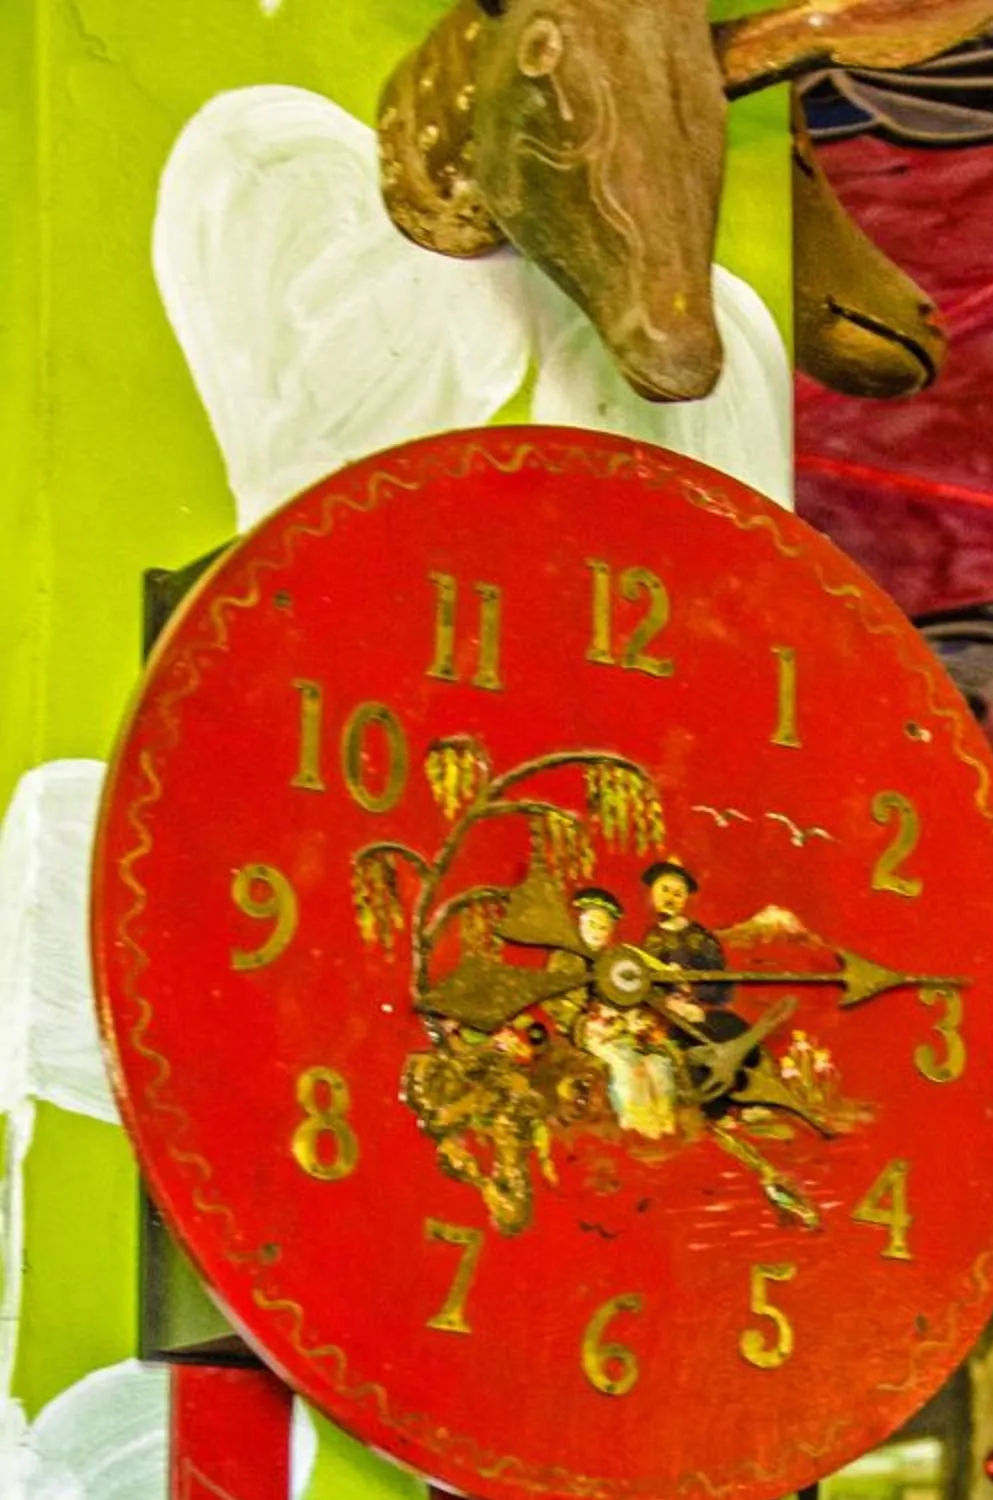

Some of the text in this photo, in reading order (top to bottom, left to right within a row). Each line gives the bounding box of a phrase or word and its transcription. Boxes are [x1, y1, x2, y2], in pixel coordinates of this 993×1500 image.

[427, 573, 504, 692] 11
[585, 558, 675, 679] 12
[291, 680, 407, 813] 10
[770, 647, 803, 748] 1
[870, 792, 923, 899] 2
[230, 864, 298, 971] 9
[912, 983, 968, 1083] 3
[292, 1067, 359, 1180] 8
[853, 1159, 913, 1261] 4
[424, 1218, 485, 1334] 7
[738, 1264, 797, 1369] 5
[581, 1293, 642, 1396] 6
